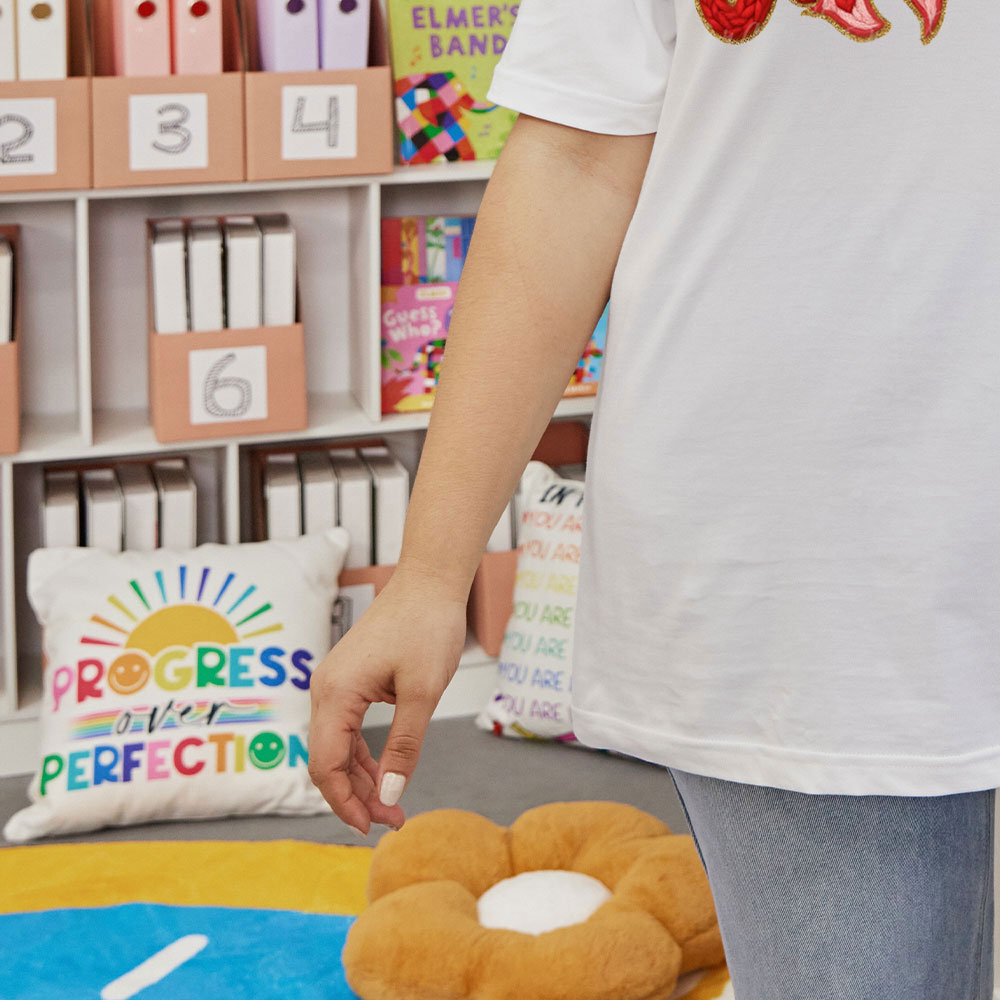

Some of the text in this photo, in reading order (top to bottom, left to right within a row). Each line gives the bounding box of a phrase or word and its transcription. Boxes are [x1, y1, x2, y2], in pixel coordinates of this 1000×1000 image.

[430, 33, 507, 59] BAND
[151, 102, 193, 156] 3
[291, 95, 340, 149] 4
[0, 113, 35, 165] 2
[383, 305, 438, 329] Guess
[387, 317, 443, 343] Who?
[203, 351, 253, 418] 6
[541, 603, 573, 628] ARE
[535, 636, 567, 660] ARE
[53, 646, 312, 713] PROGRESS
[531, 666, 565, 691] ARE
[115, 699, 258, 735] over
[530, 699, 562, 721] ARE
[40, 732, 310, 796] PERFECTION
